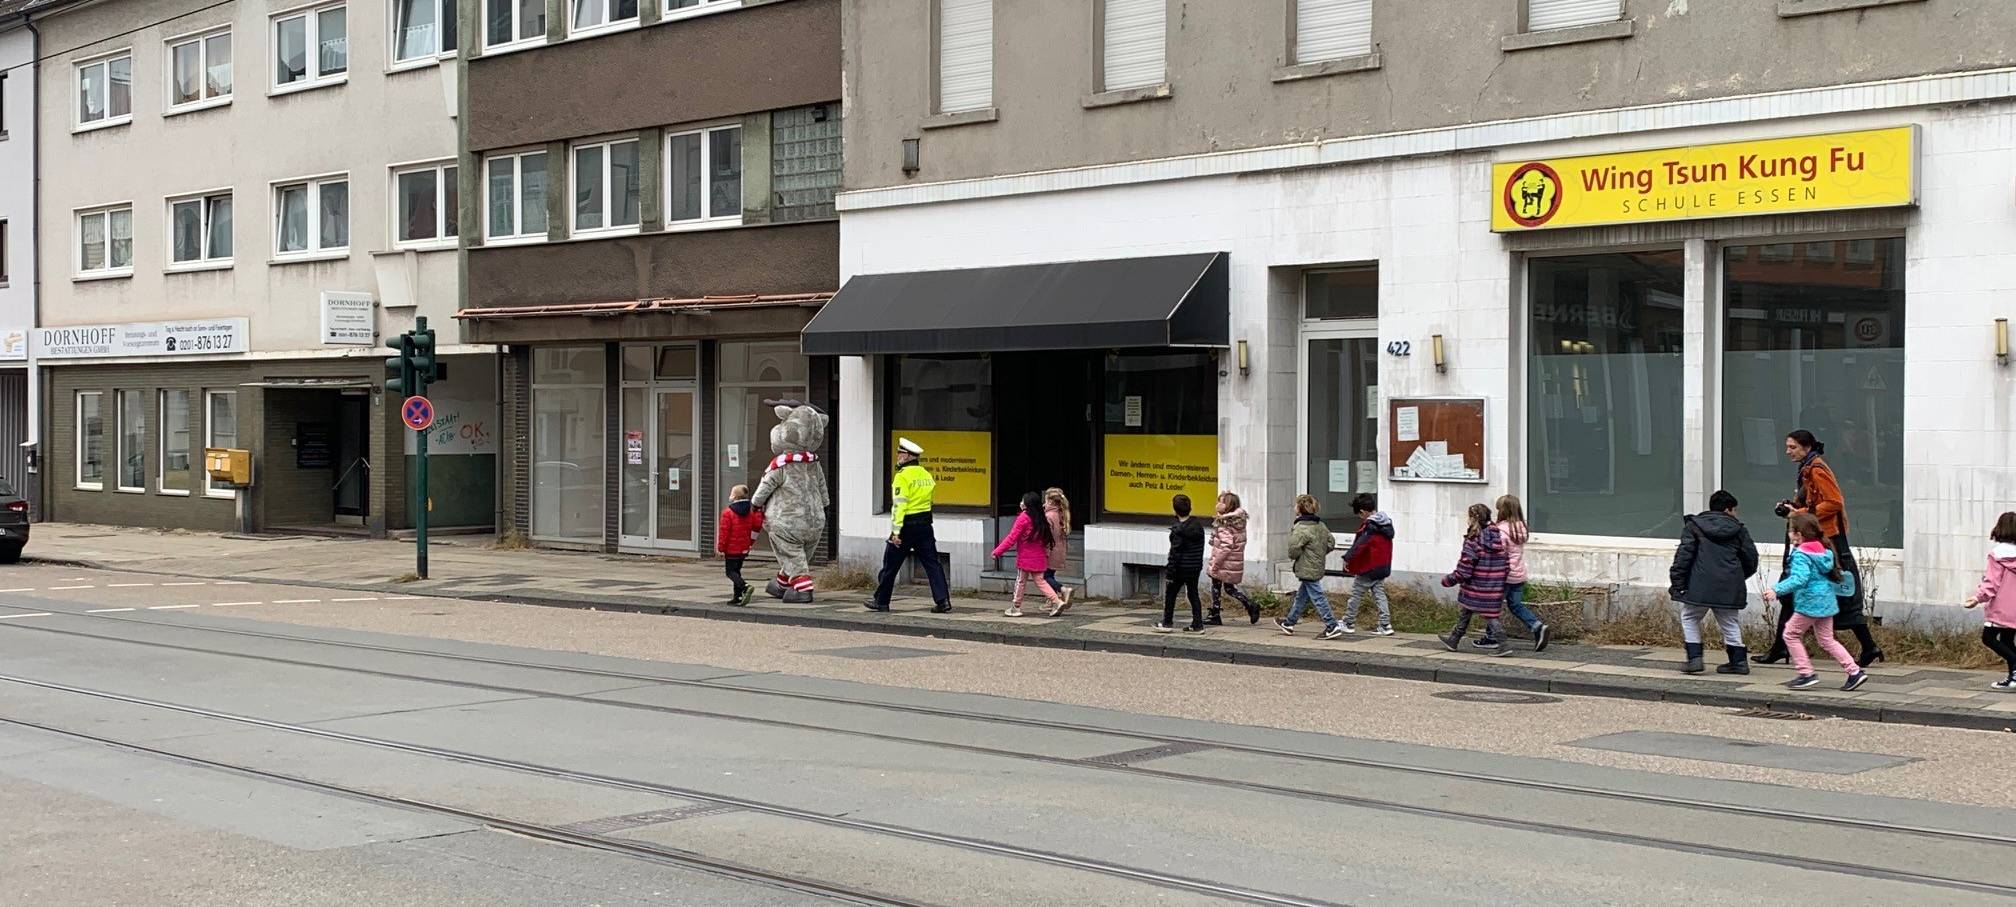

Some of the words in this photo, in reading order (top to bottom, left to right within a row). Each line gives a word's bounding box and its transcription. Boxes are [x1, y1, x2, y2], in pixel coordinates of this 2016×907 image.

[1581, 165, 1653, 193] Wing
[1663, 160, 1727, 186] Tsun
[1739, 153, 1817, 181] Kung
[1830, 146, 1865, 173] Fu
[1622, 193, 1718, 214] SCHULE
[1738, 186, 1818, 206] ESSEN
[44, 328, 116, 346] DORNHOFF
[180, 335, 212, 350] 0201-876
[213, 335, 221, 349] 13
[223, 334, 232, 349] 27
[1386, 340, 1411, 356] 422
[942, 465, 986, 474] Kinderbekleidung
[1130, 460, 1151, 469] ändern
[1166, 464, 1209, 472] modernisieren
[1136, 471, 1159, 479] Herren-
[1145, 481, 1158, 489] Pelz
